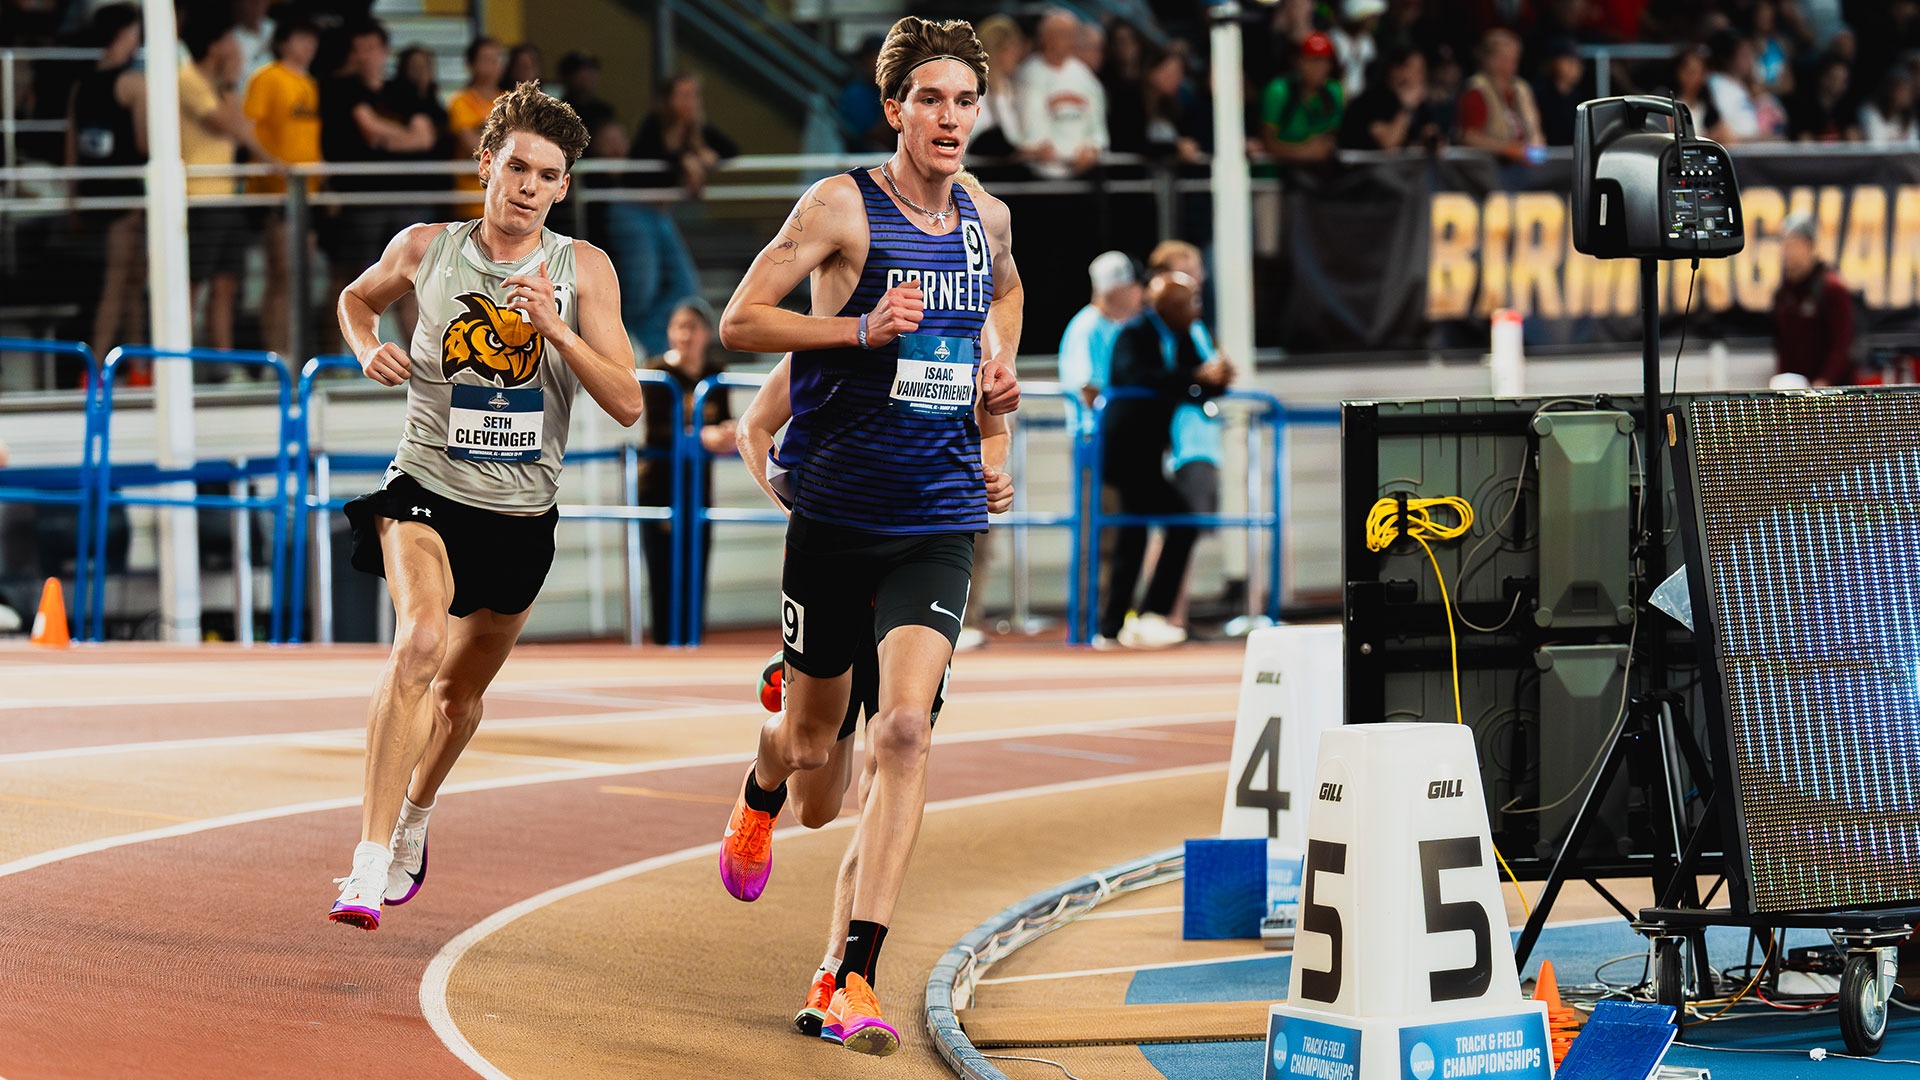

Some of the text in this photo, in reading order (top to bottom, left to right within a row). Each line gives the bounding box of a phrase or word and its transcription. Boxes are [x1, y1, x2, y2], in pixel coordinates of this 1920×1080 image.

[965, 223, 984, 272] 9
[924, 367, 954, 382] ISAAC
[896, 380, 972, 401] VANWESTRIENEN
[483, 416, 512, 430] SETH
[455, 428, 536, 447] CLEVENGER
[783, 600, 799, 645] 9
[1236, 717, 1290, 839] 4
[1427, 779, 1464, 799] GILL
[1318, 782, 1344, 803] GILL
[1301, 838, 1348, 1004] 5
[1418, 836, 1493, 1003] 5
[1302, 1036, 1346, 1060] TRACK & FIELD
[1456, 1030, 1524, 1054] TRACK & FIELD
[1290, 1053, 1354, 1080] CHAMPIONSHIPS
[1443, 1047, 1541, 1079] CHAMPIONSHIPS
